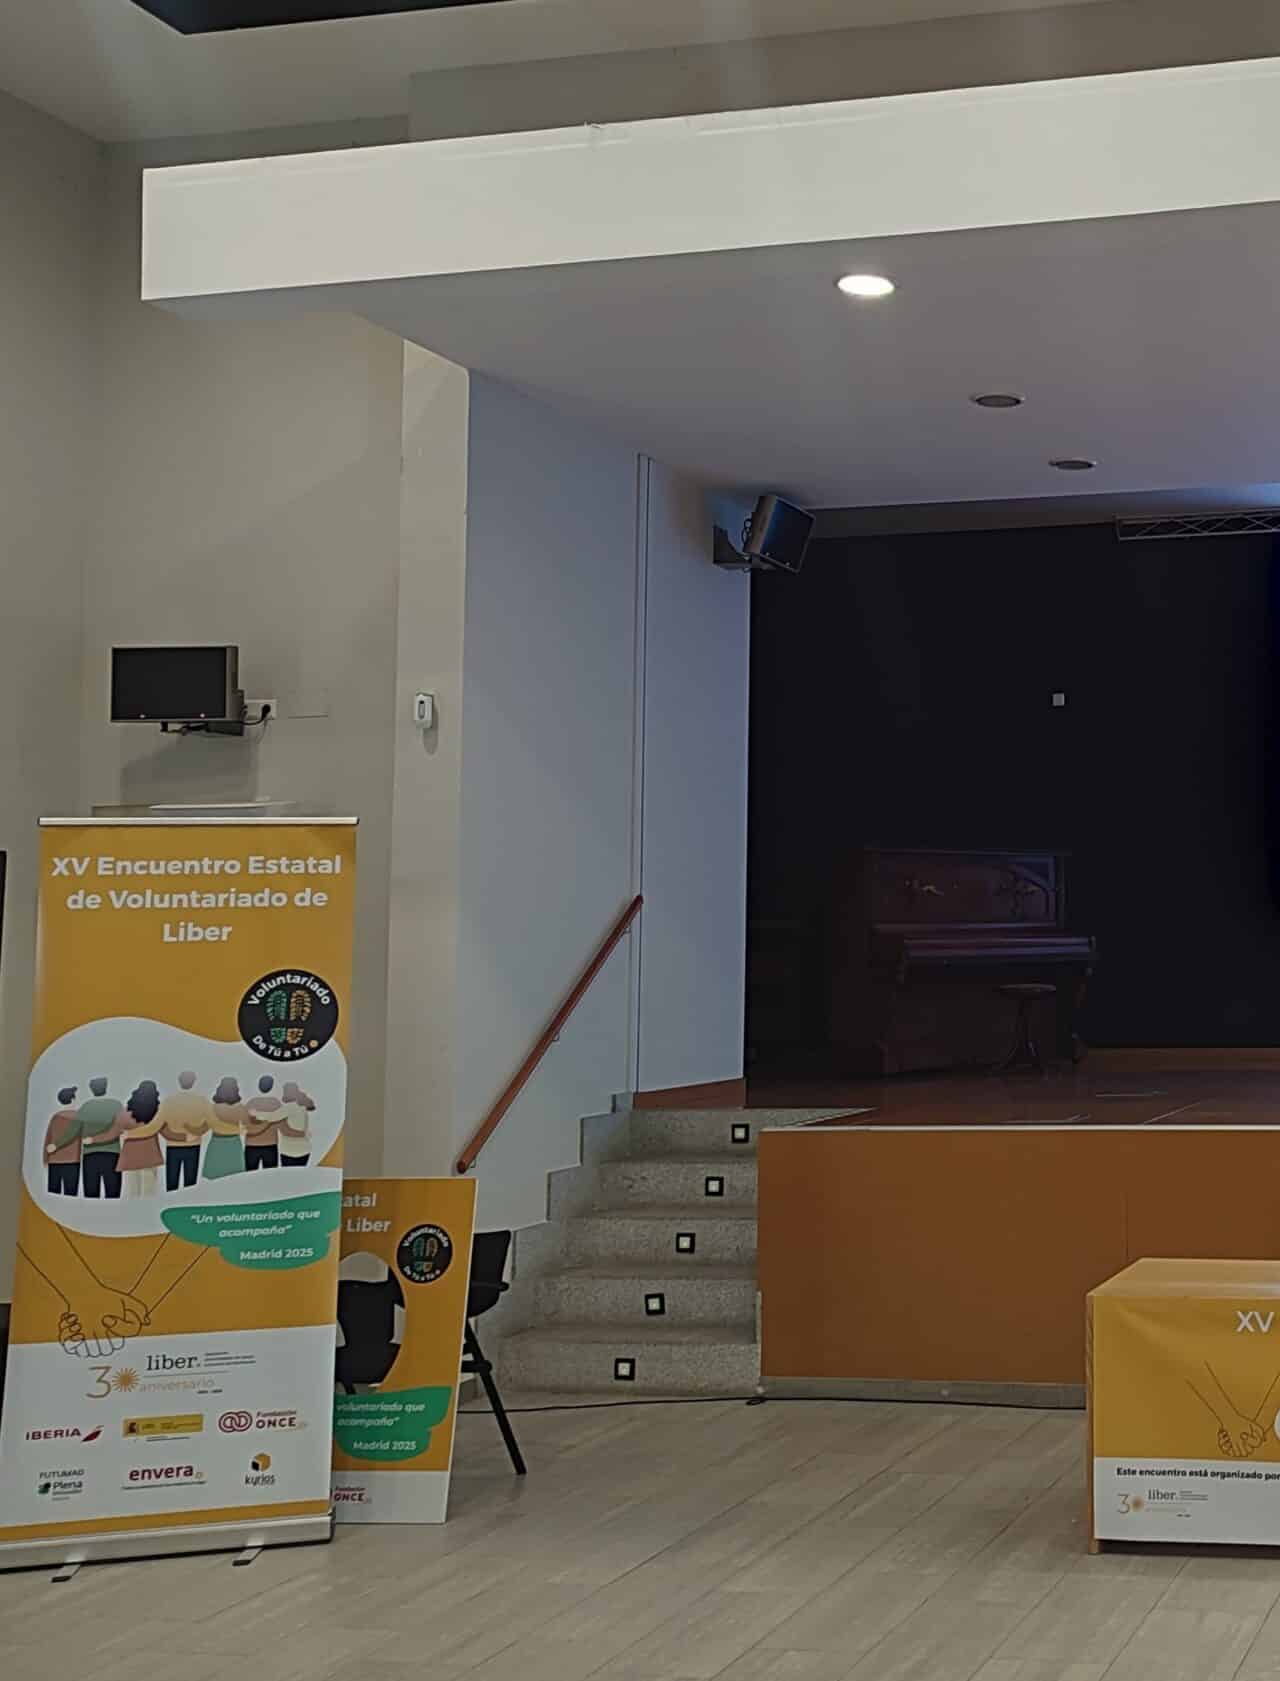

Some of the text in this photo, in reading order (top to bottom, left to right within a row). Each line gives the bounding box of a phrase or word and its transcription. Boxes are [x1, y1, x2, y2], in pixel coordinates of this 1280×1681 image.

[51, 855, 342, 877] XV Encuentro Estatal
[66, 887, 329, 910] de Voluntariado de
[163, 922, 233, 942] Liber
[247, 974, 331, 1005] Voluntariado
[343, 1193, 377, 1207] atal
[216, 1210, 295, 1223] voluntariado
[297, 1210, 321, 1221] que
[347, 1218, 392, 1233] Liber
[240, 1248, 314, 1260] Madrid 2025
[1236, 1311, 1275, 1333] XV
[256, 1417, 297, 1430] ONCE
[25, 1428, 82, 1441] IBERIA
[129, 1464, 194, 1481] envera
[1116, 1467, 1137, 1476] Este
[1139, 1469, 1187, 1477] encuentro
[1188, 1469, 1209, 1478] está
[1210, 1470, 1264, 1480] organizado
[53, 1480, 83, 1491] Plena
[245, 1474, 276, 1487] kyrios
